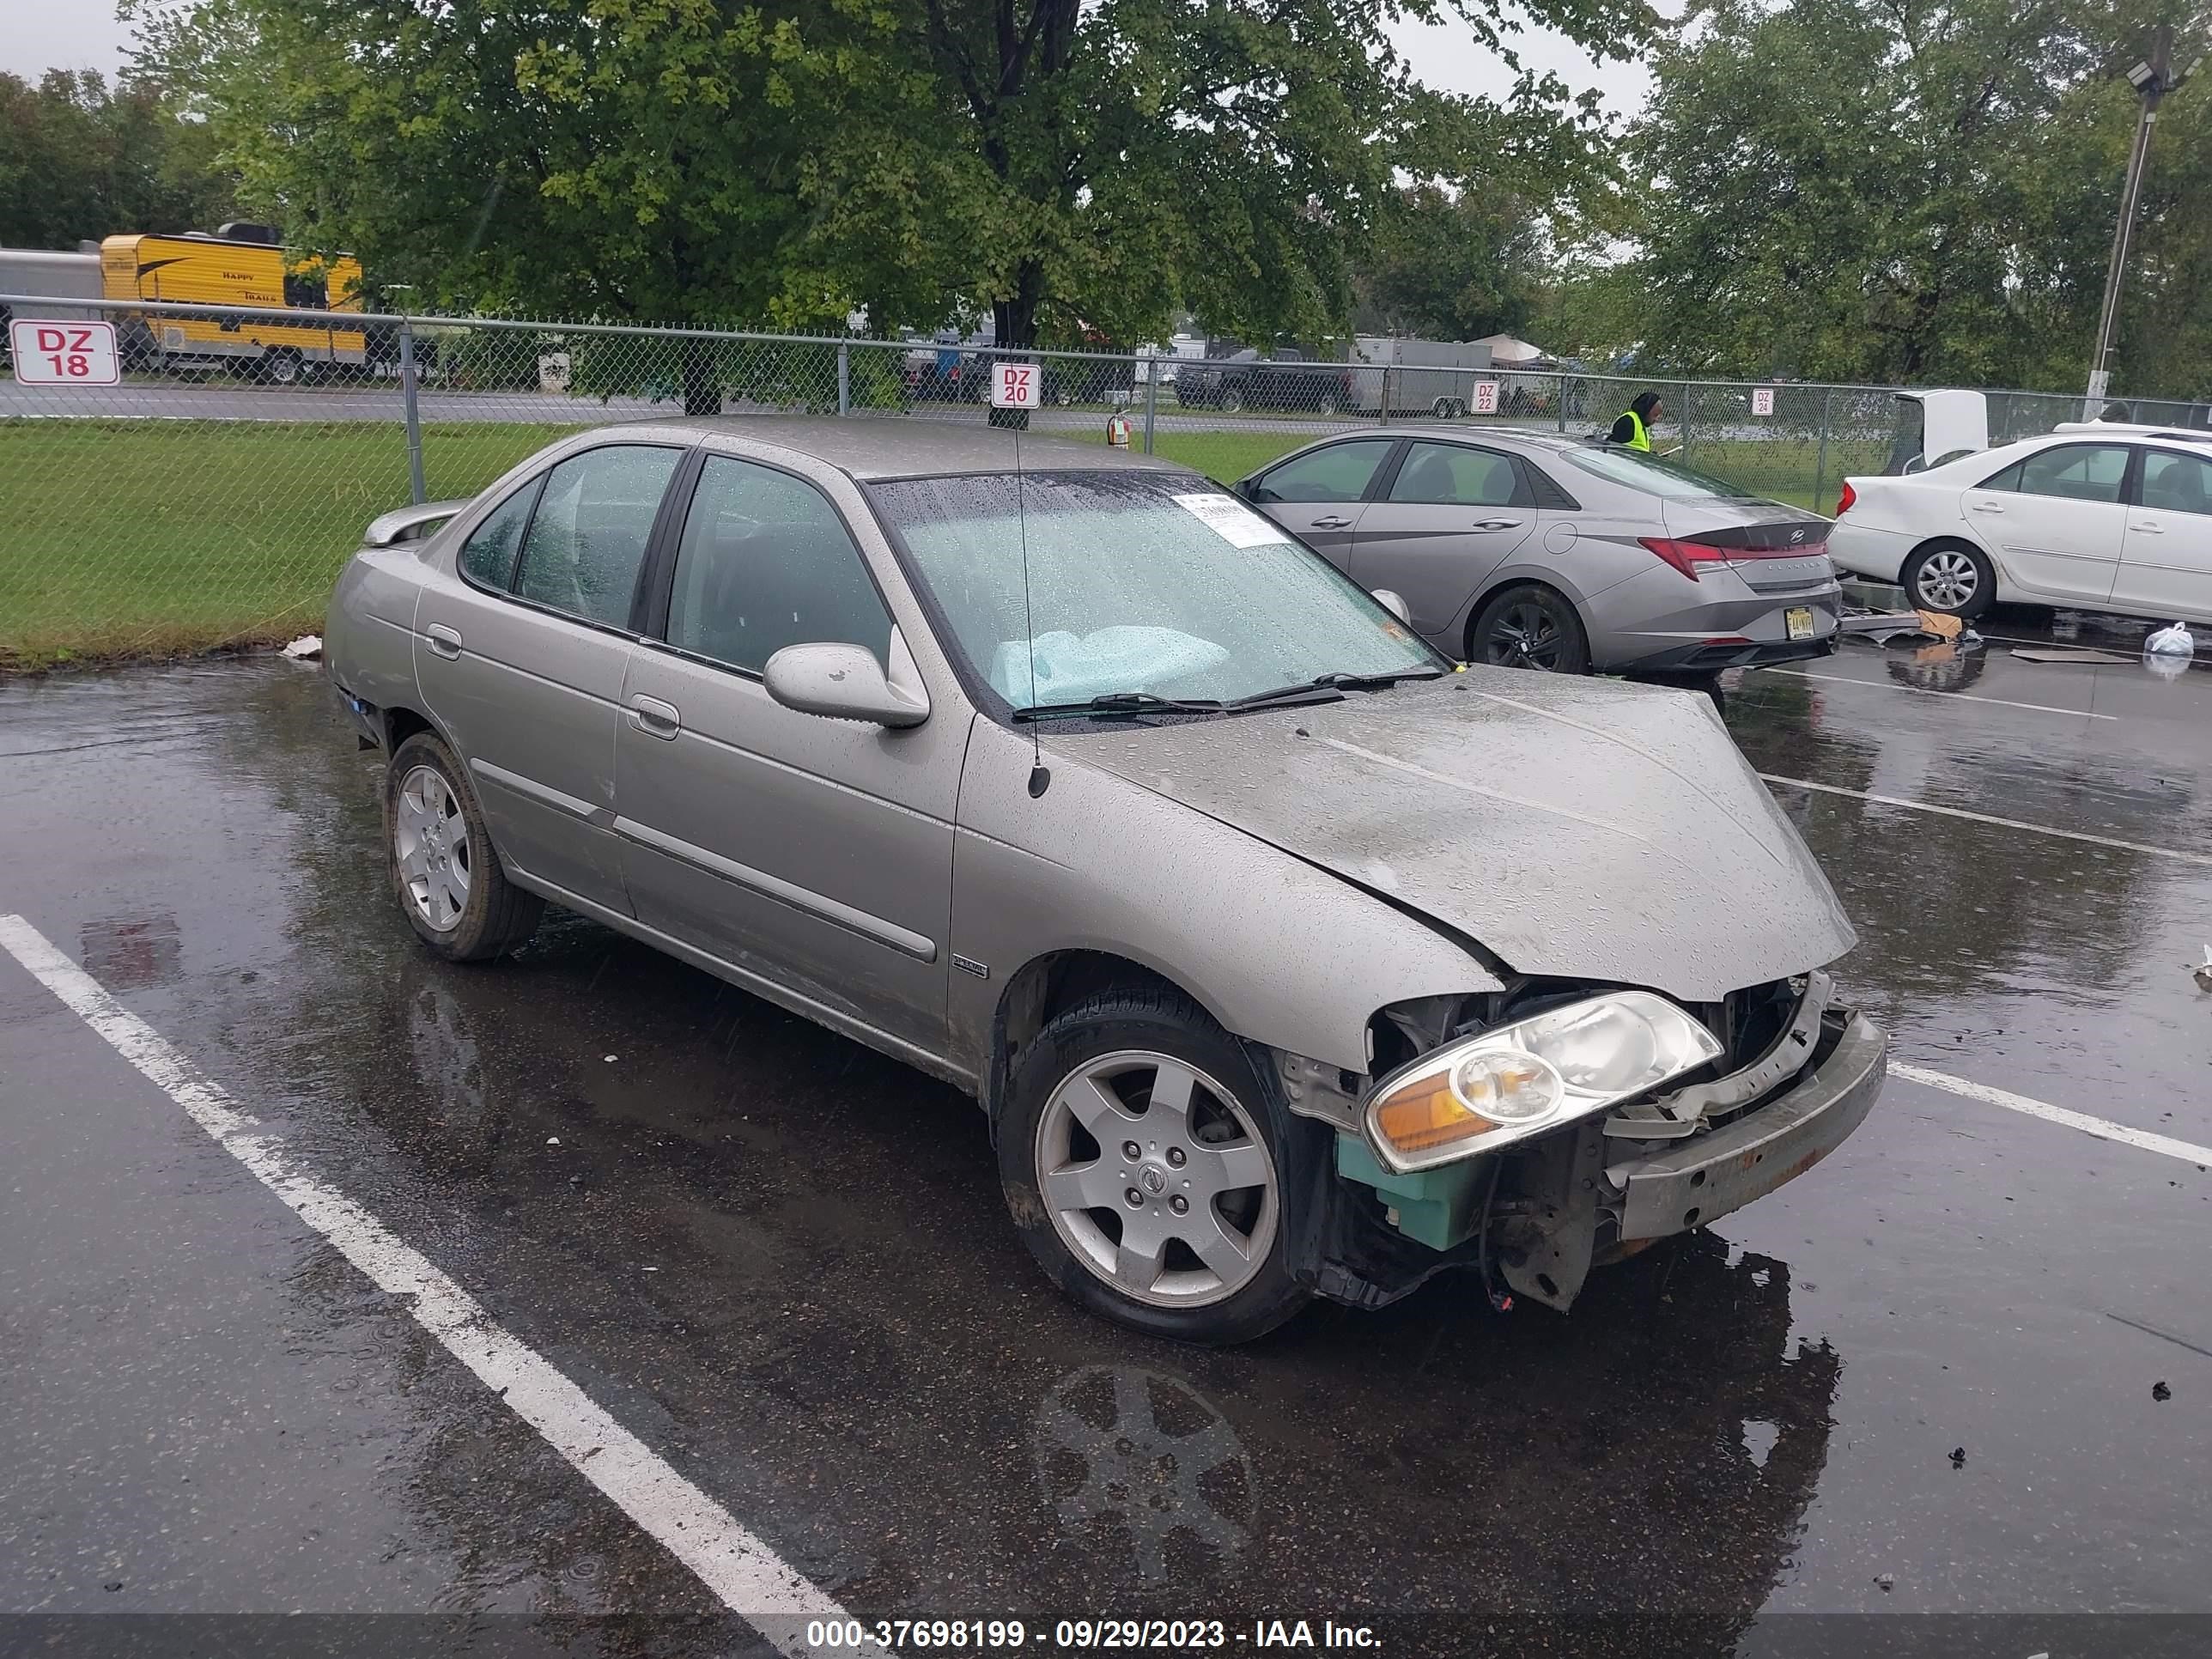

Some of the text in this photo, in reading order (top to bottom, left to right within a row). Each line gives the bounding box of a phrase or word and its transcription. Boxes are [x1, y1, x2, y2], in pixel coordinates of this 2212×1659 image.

[222, 271, 254, 281] HAPPY
[37, 329, 94, 352] DZ
[47, 355, 89, 376] 18
[1005, 369, 1030, 386] DZ
[1005, 386, 1027, 402] 20
[1479, 386, 1494, 397] DZ
[1758, 392, 1770, 402] DZ
[1479, 398, 1492, 410] 22
[1759, 403, 1768, 412] 24
